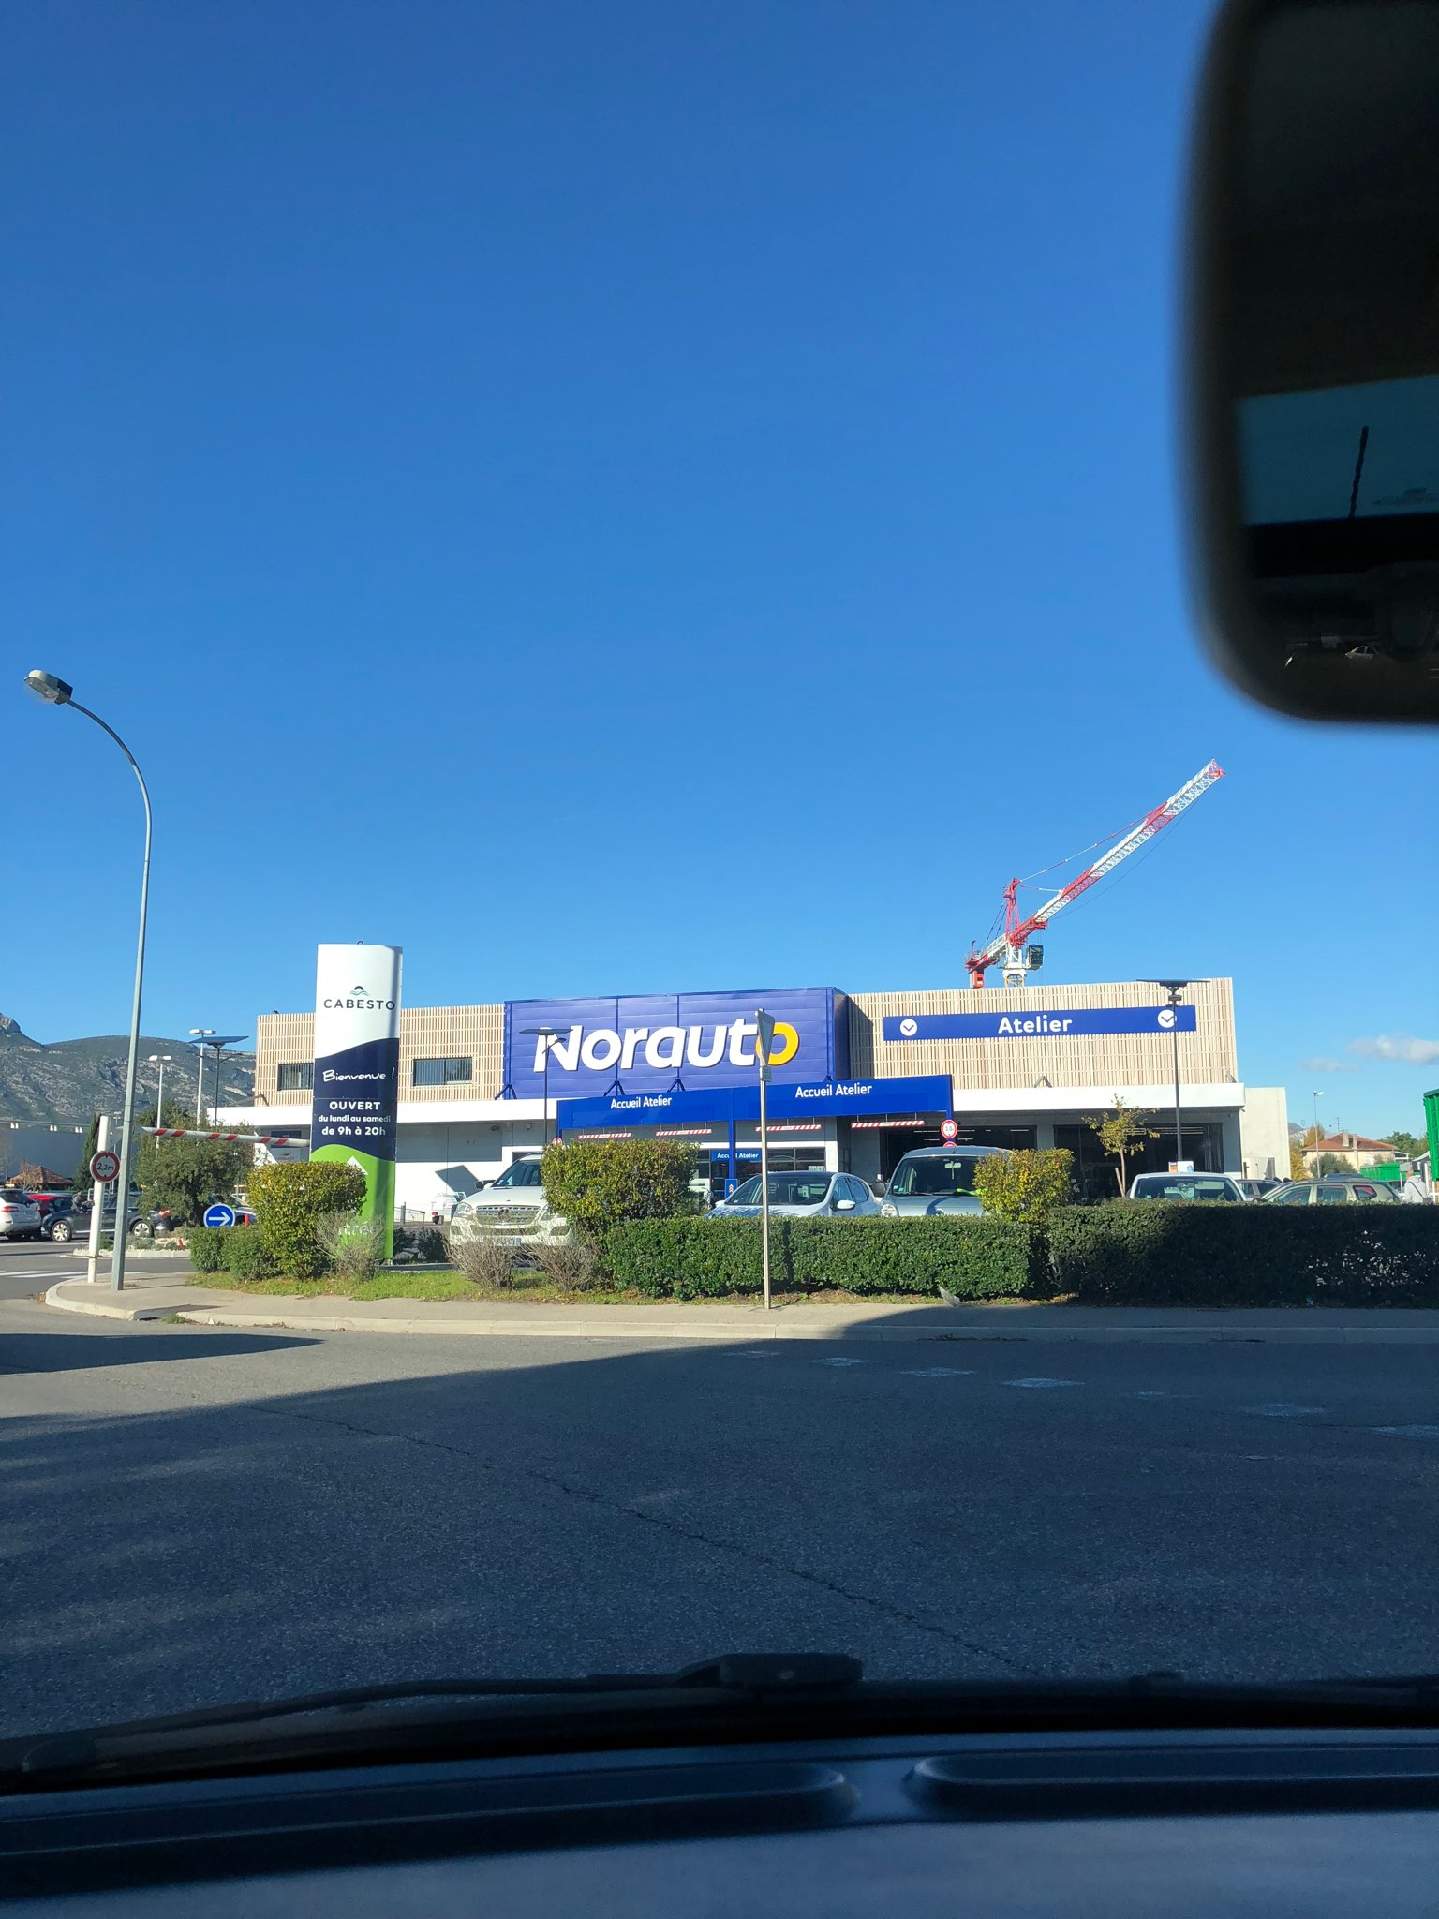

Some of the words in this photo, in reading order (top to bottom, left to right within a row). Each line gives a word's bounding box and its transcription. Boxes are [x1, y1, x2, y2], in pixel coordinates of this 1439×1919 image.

[323, 998, 395, 1011] CABESTO
[998, 1014, 1073, 1034] Atelier
[533, 1018, 799, 1073] Norauto
[322, 1069, 387, 1082] Bienvenue
[794, 1083, 833, 1098] Accueil
[834, 1081, 873, 1096] Atelier
[329, 1101, 381, 1111] OUVERT
[610, 1096, 641, 1109] Accueil
[643, 1094, 673, 1108] Atelier
[318, 1114, 328, 1123] du
[329, 1114, 350, 1123] lundi
[350, 1115, 361, 1123] au
[362, 1114, 392, 1123] samedi
[321, 1126, 335, 1136] de
[337, 1126, 352, 1136] 9h
[354, 1125, 363, 1136] à
[364, 1126, 387, 1136] 20h
